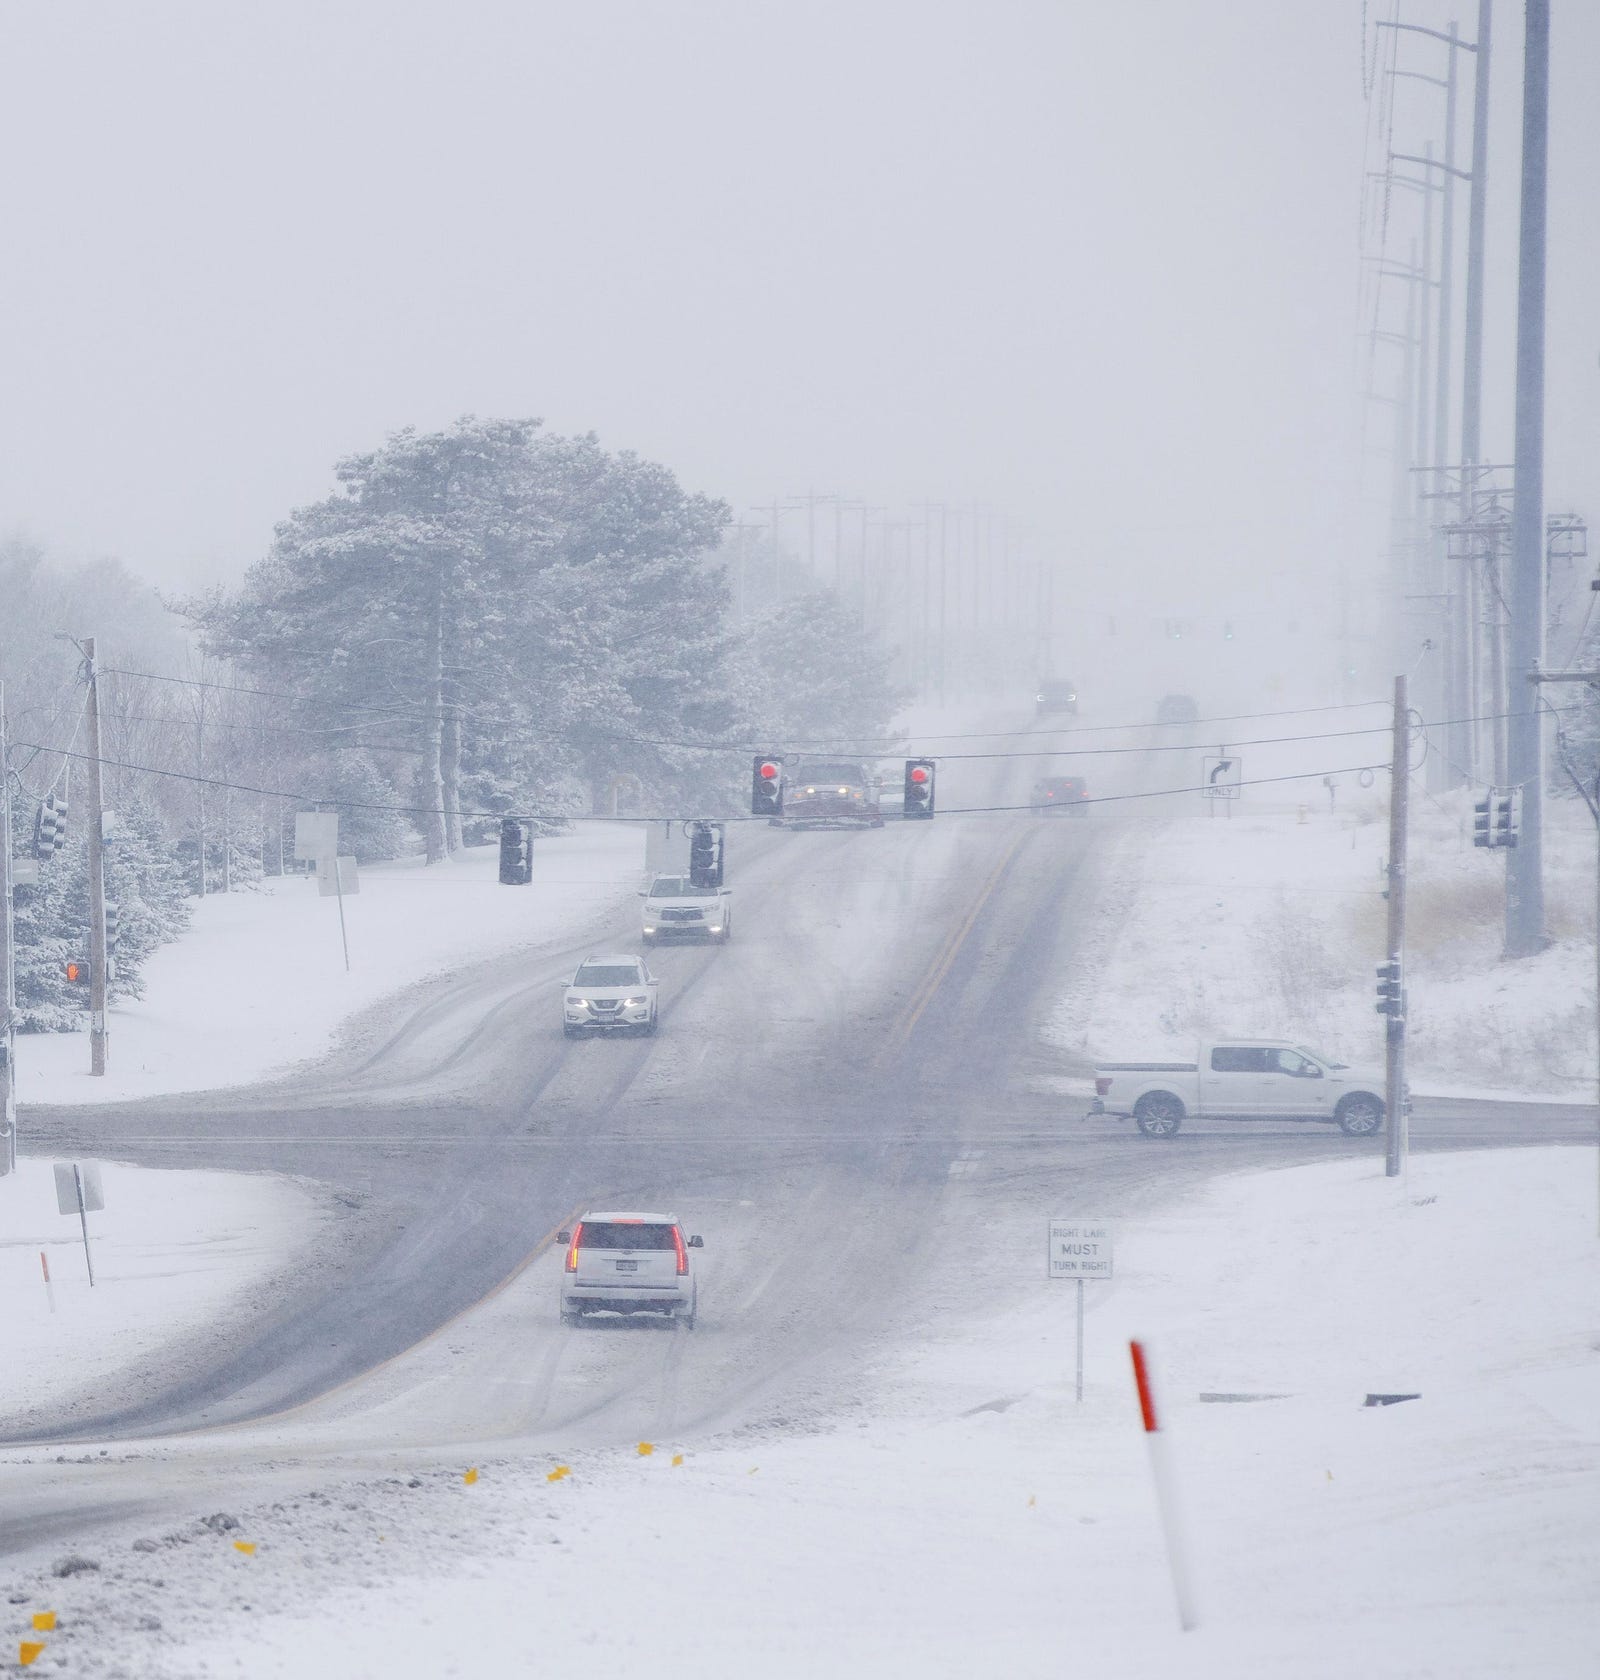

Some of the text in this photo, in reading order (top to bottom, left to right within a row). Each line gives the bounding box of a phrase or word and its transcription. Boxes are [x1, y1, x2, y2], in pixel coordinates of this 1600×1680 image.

[1208, 787, 1232, 796] ONLY
[1053, 1228, 1080, 1238] RIGHT
[1062, 1243, 1100, 1255] MUST
[1053, 1261, 1108, 1270] TURN RIGHT
